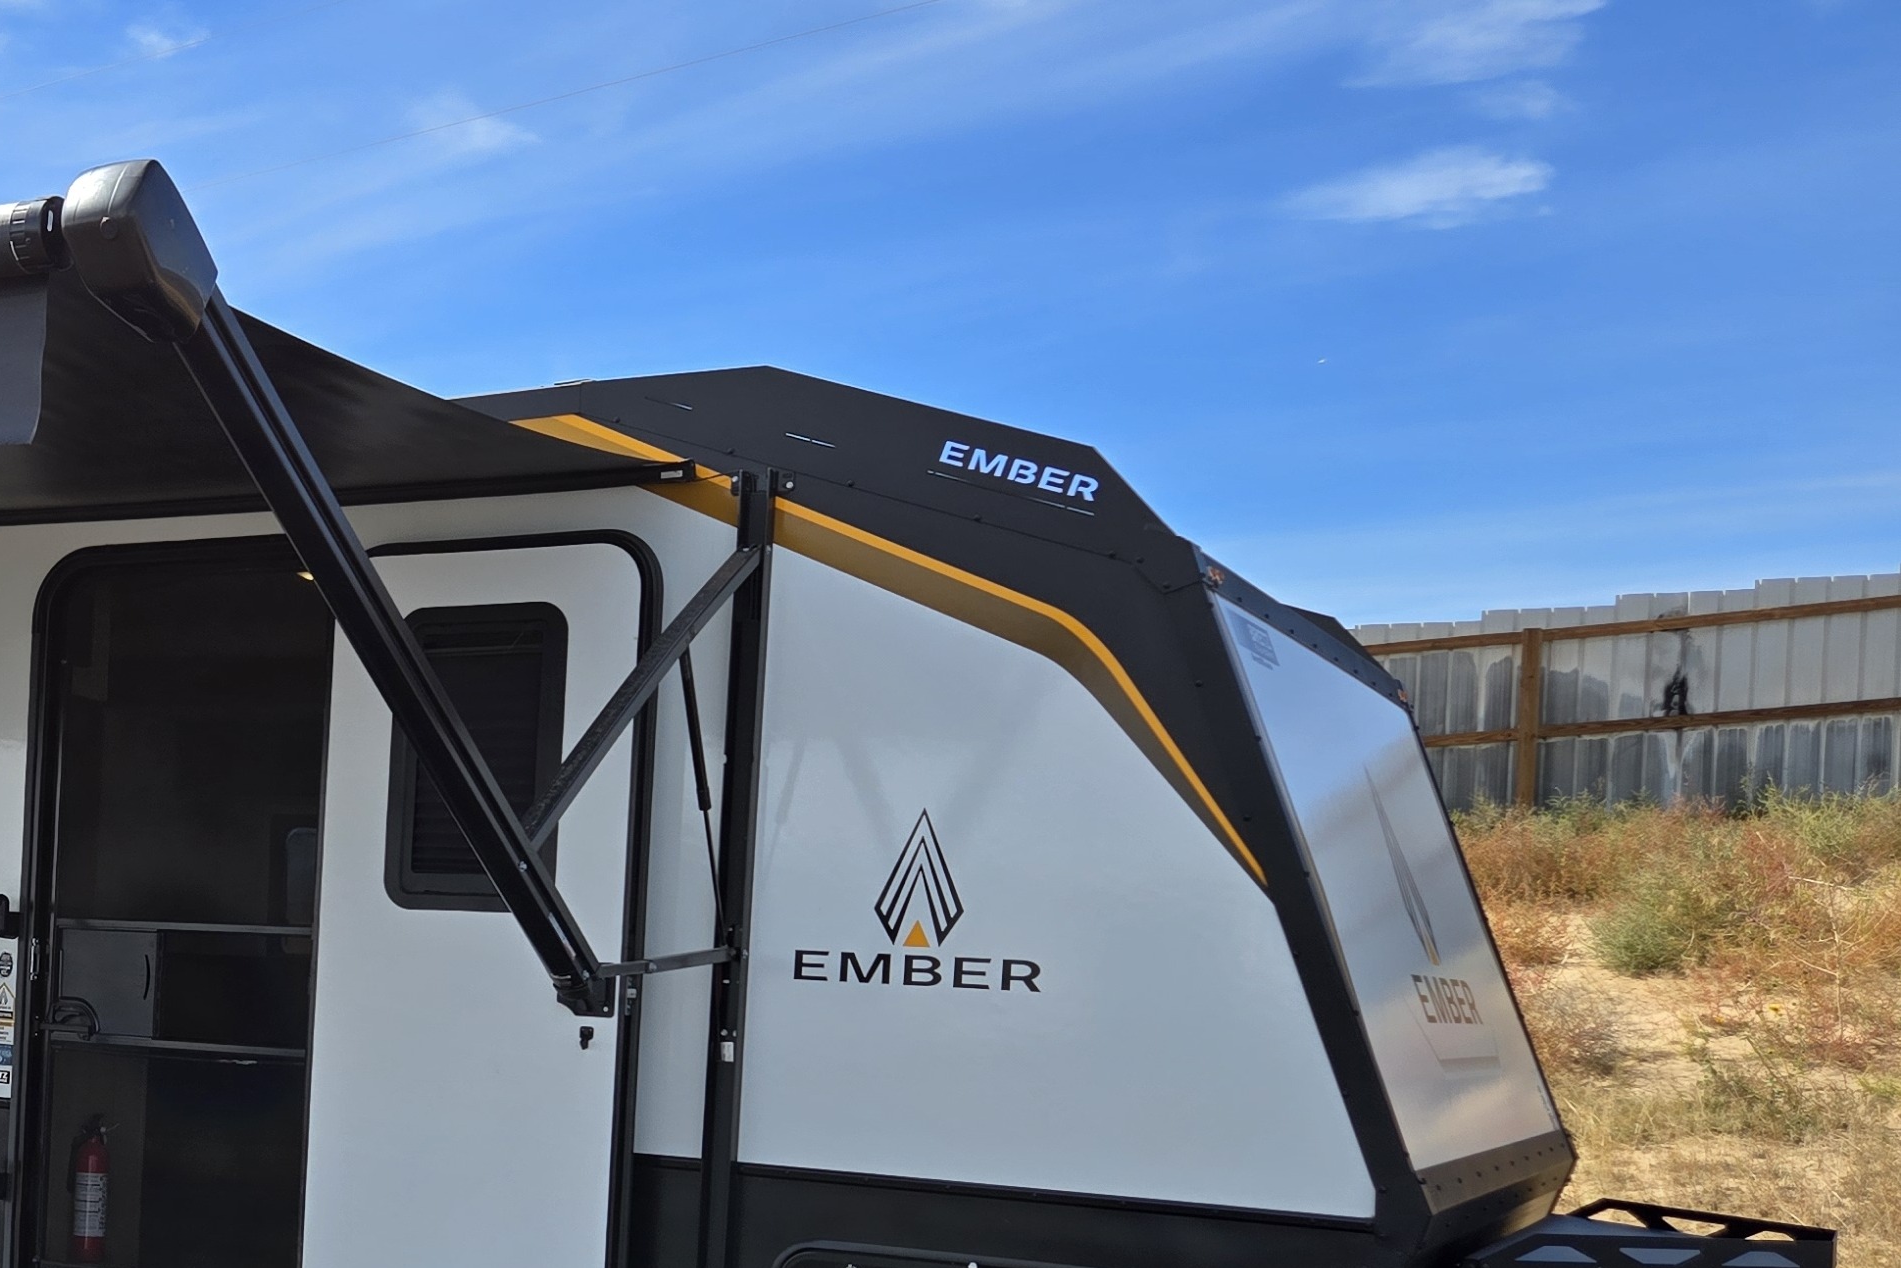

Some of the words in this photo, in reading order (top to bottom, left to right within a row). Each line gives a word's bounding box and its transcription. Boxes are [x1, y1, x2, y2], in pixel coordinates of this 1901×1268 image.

[939, 440, 1099, 502] EMBER
[793, 949, 1041, 993] EMBER
[1410, 973, 1483, 1025] EMBER
